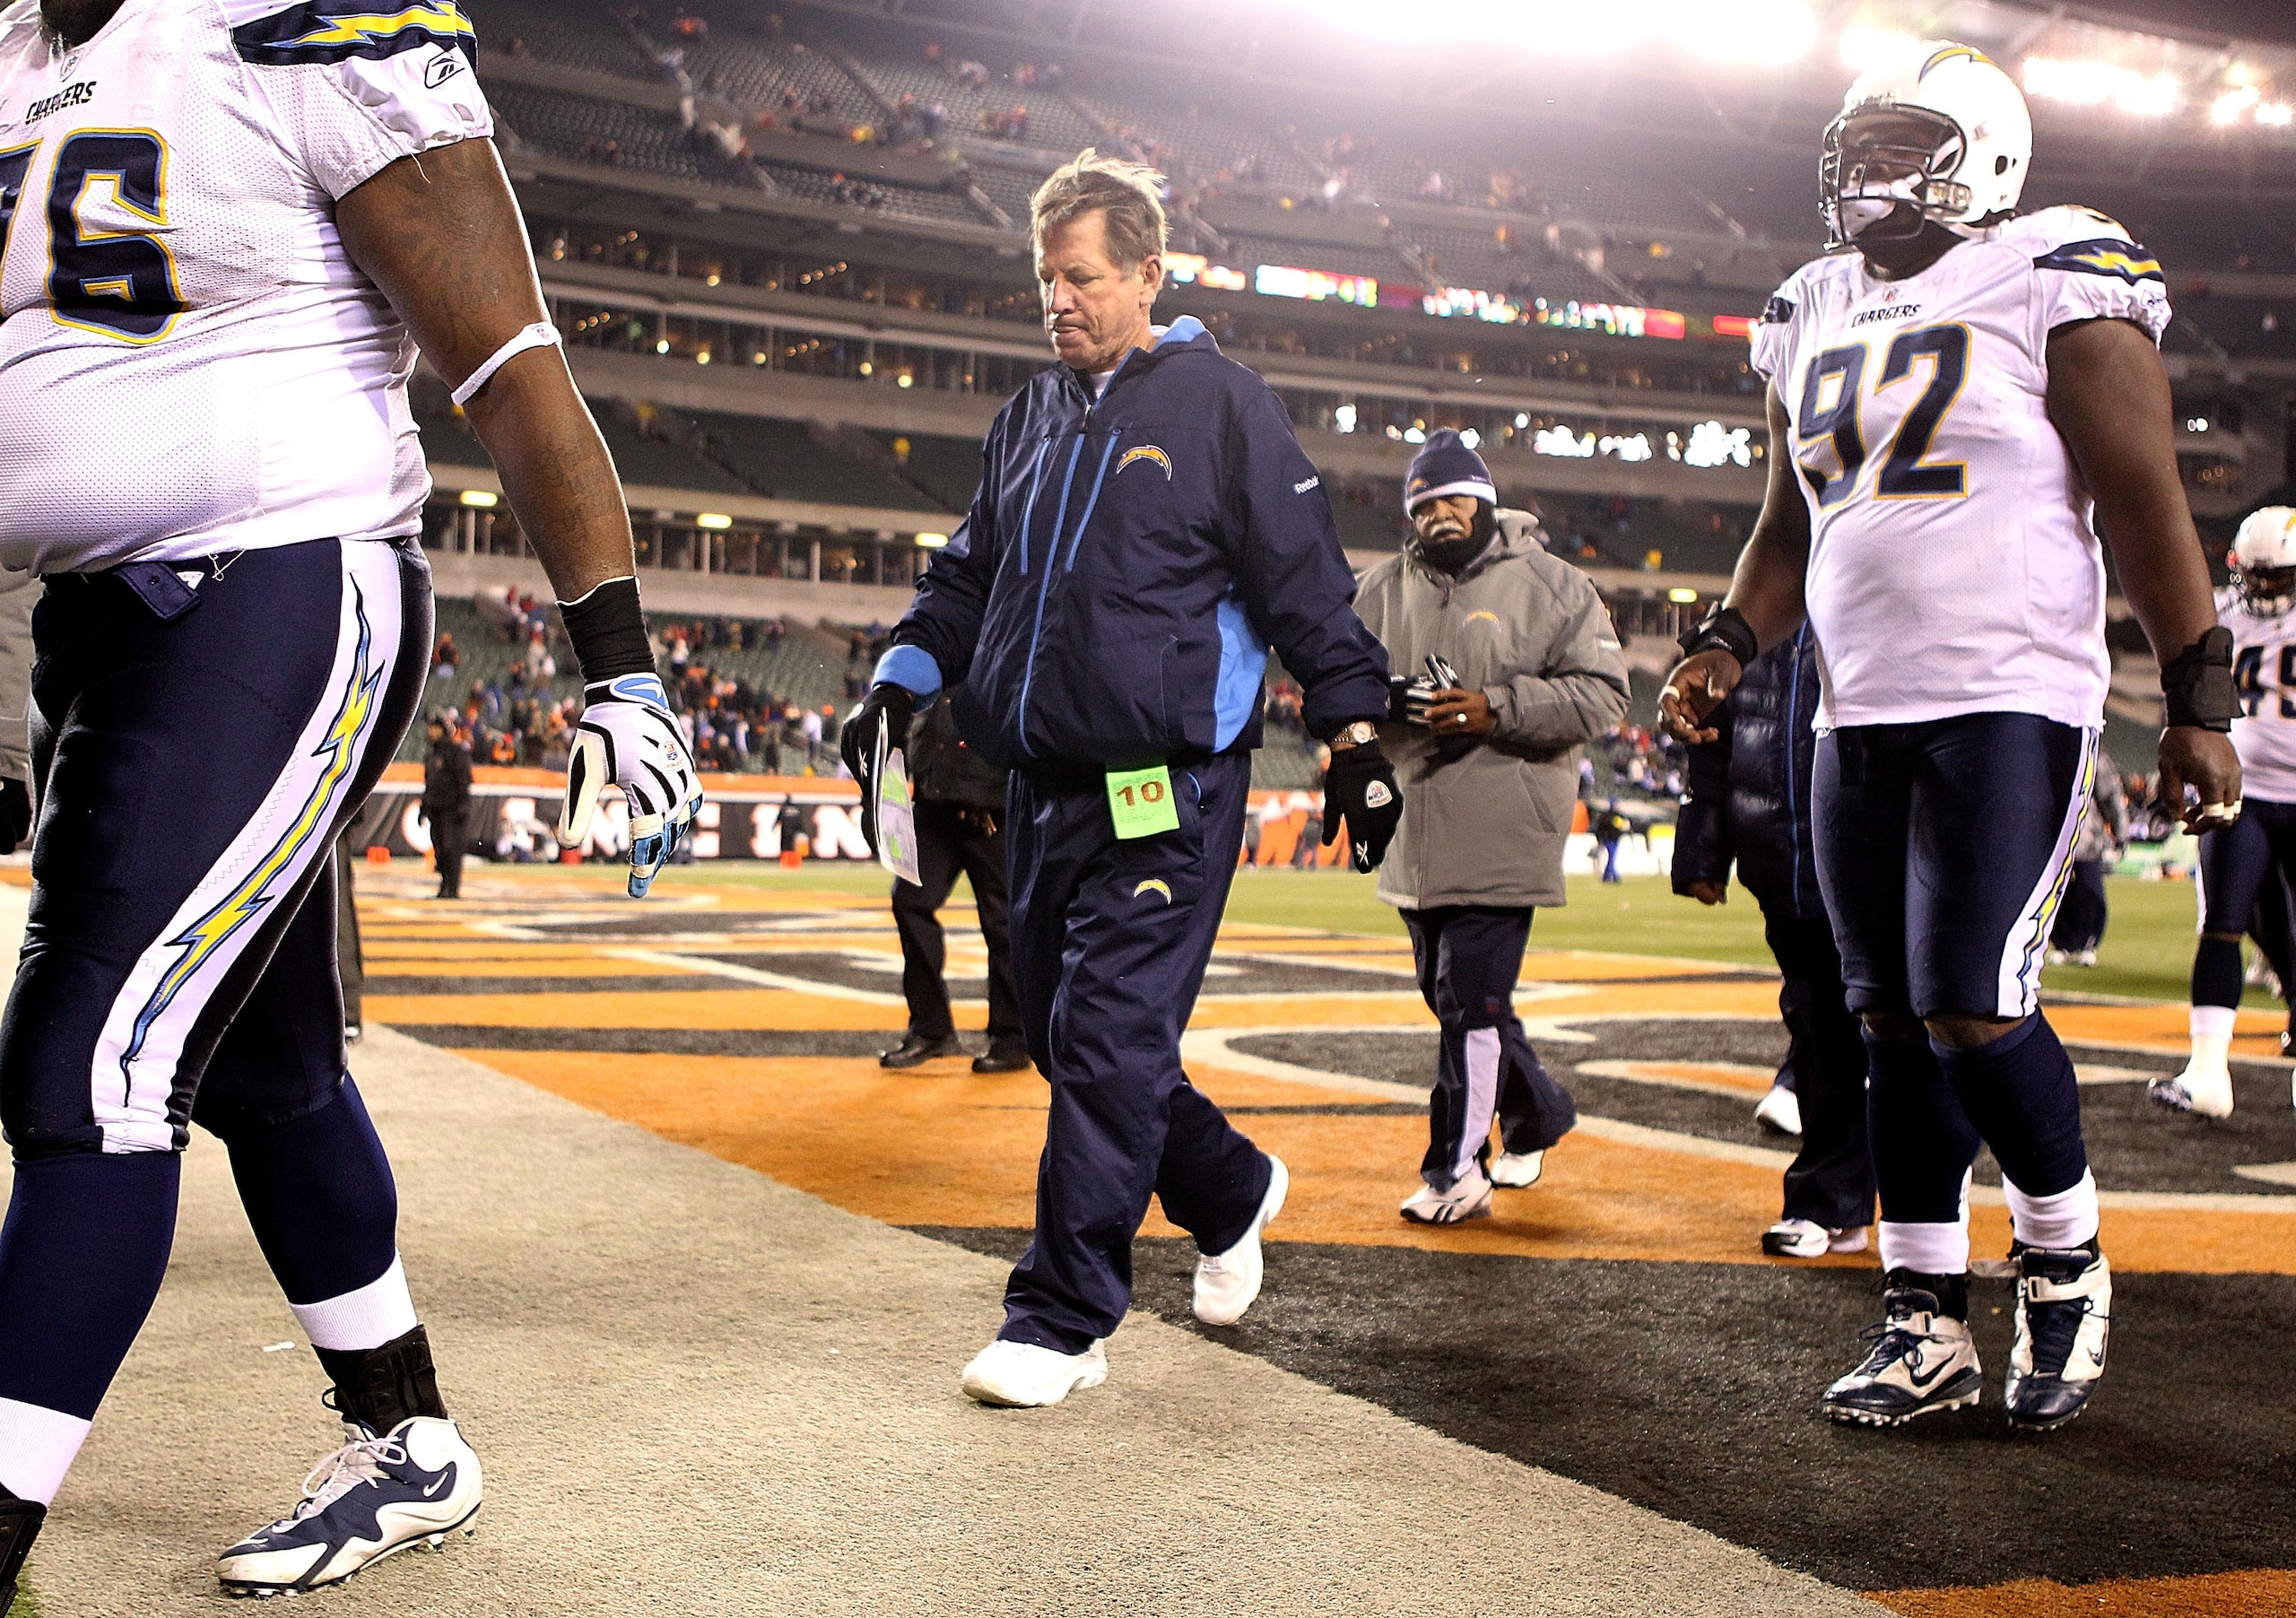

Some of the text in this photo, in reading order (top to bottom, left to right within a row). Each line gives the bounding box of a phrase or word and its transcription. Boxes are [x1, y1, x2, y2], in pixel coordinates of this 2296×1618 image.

[1851, 304, 1921, 328] CHARGERS
[1796, 320, 1971, 514] 92
[1116, 780, 1164, 807] 10
